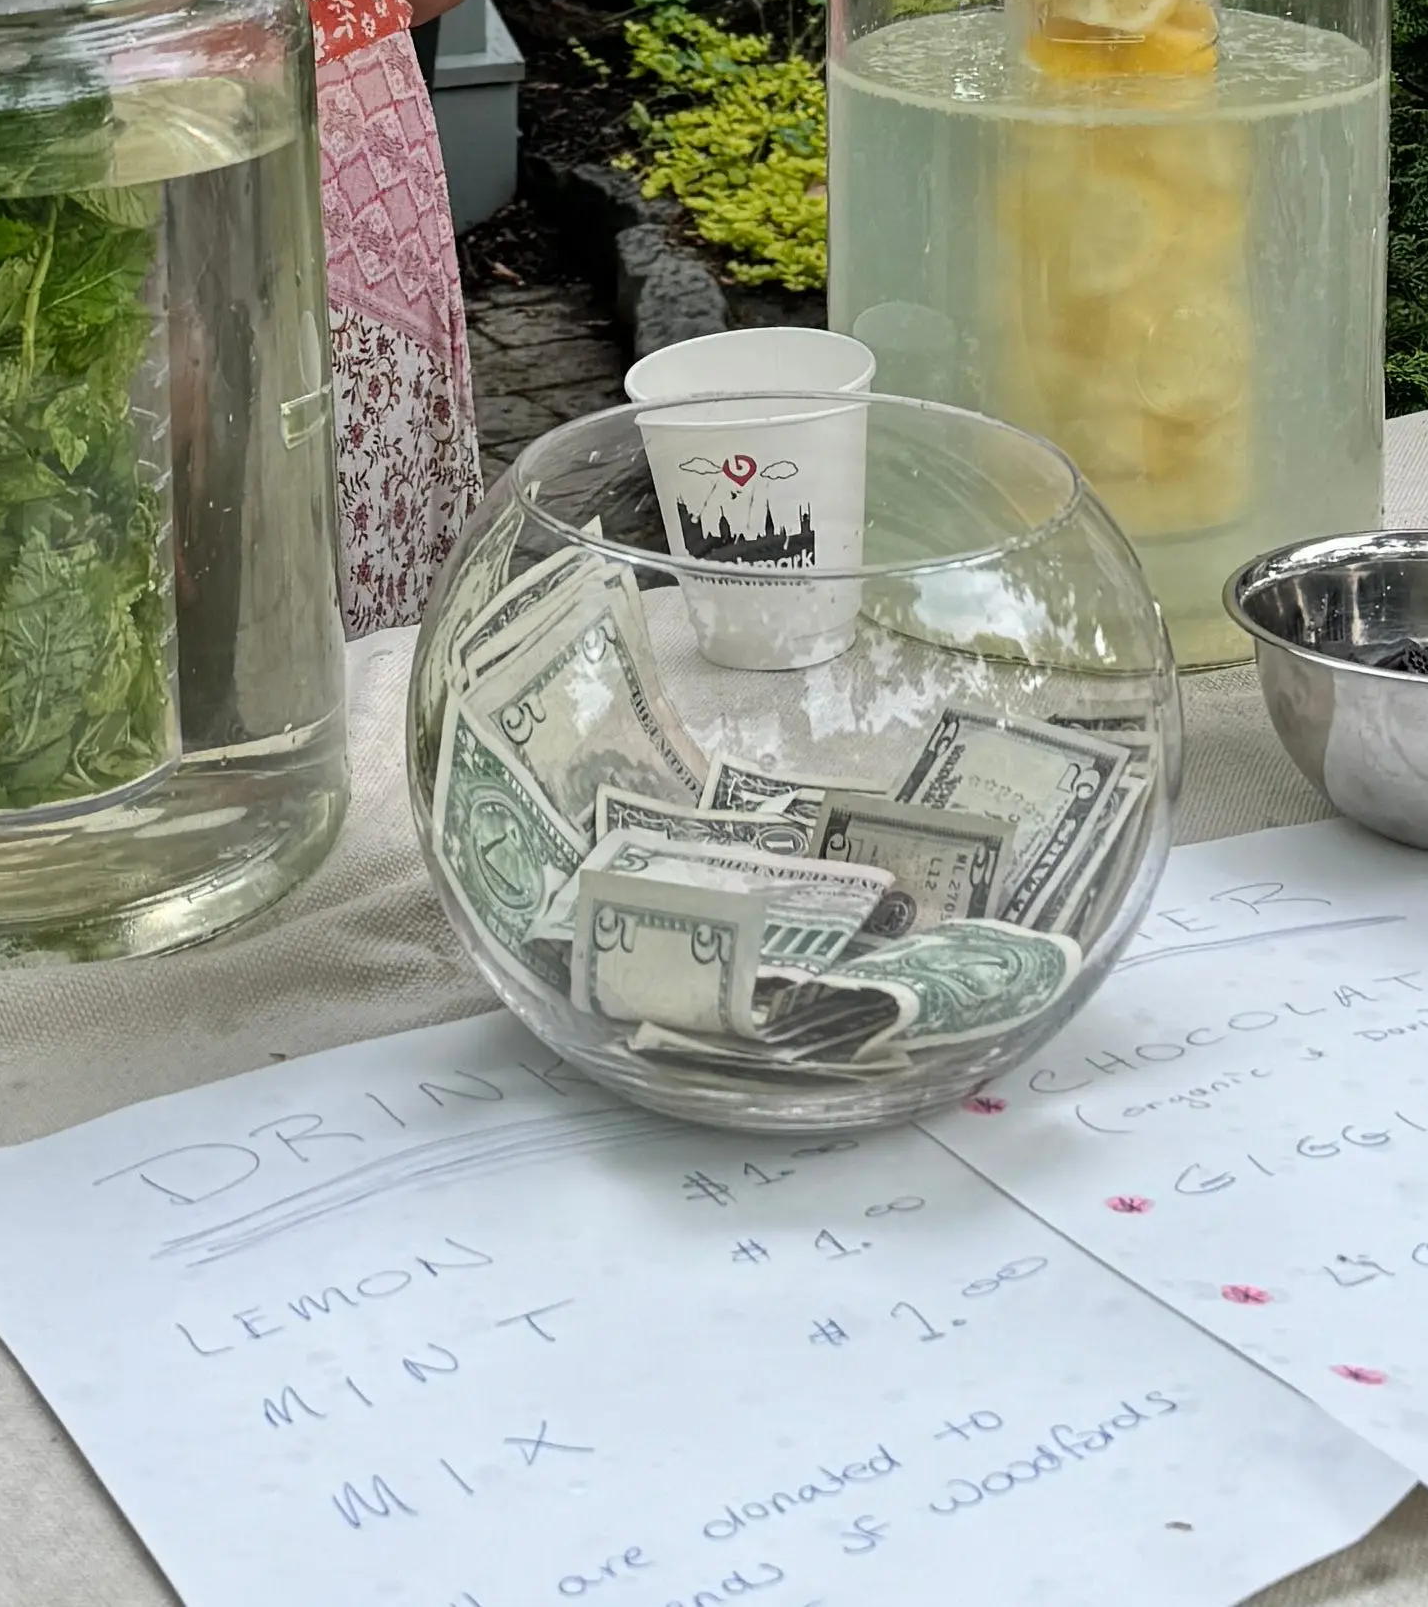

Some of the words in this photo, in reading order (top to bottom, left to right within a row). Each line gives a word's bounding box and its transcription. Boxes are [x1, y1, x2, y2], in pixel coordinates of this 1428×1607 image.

[92, 1058, 601, 1206] DRINK
[175, 1236, 494, 1358] LEMON
[262, 1297, 575, 1429] MINT
[331, 1420, 595, 1529] MIX
[702, 1443, 903, 1542] donated
[934, 1410, 1004, 1443] to
